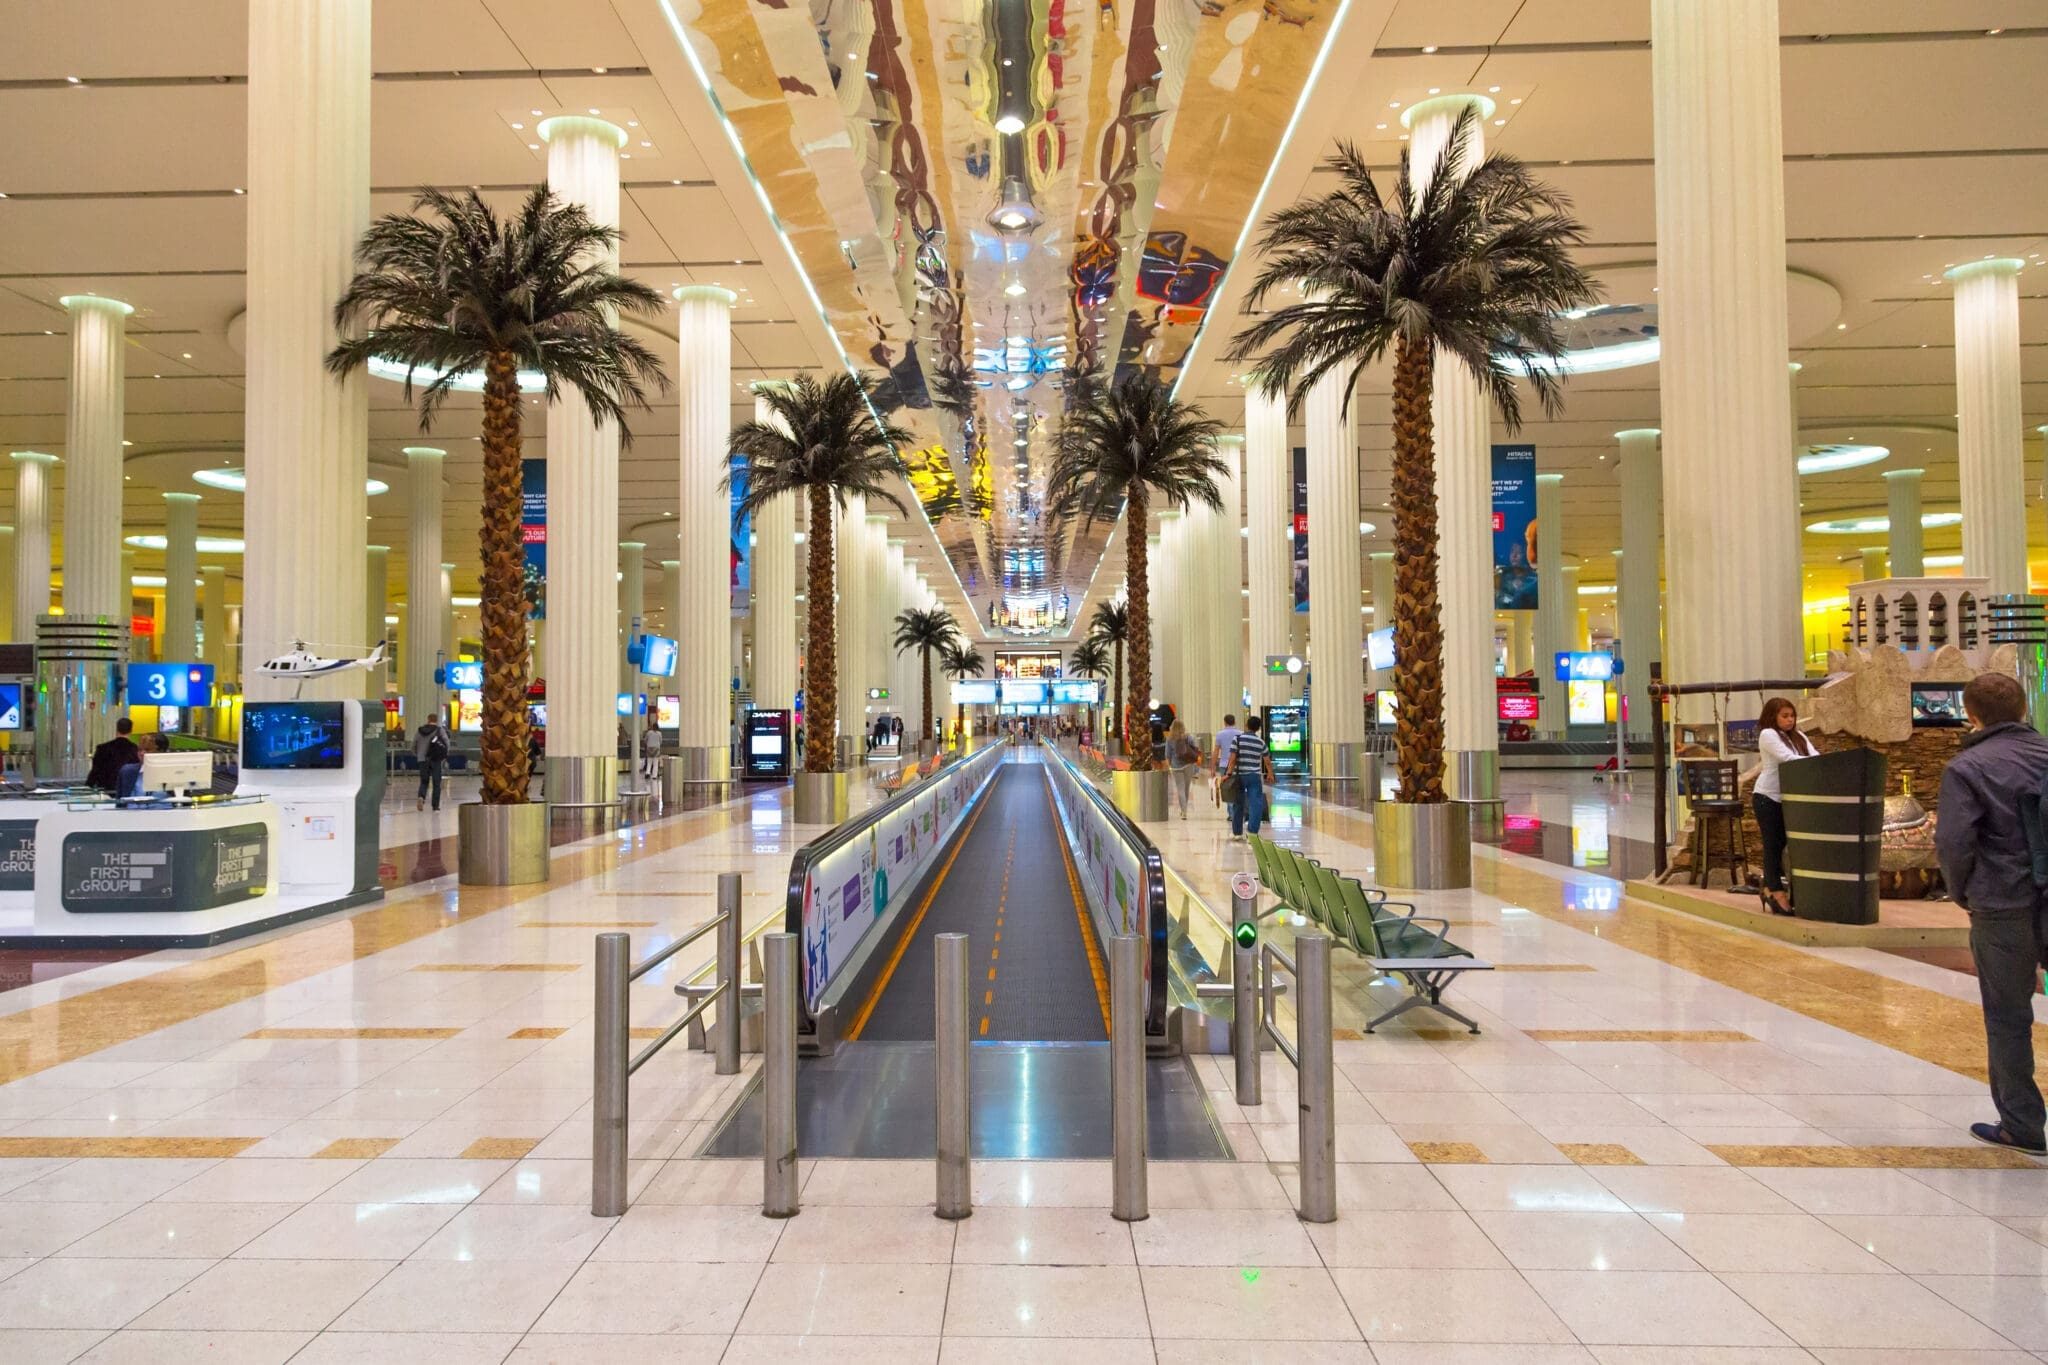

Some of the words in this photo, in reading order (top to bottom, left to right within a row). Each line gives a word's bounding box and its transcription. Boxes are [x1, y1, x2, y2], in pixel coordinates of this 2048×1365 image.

[1575, 656, 1604, 676] 4A
[451, 666, 482, 685] 3A
[148, 673, 167, 699] 3
[19, 839, 36, 850] TH
[9, 850, 36, 861] FIRS
[102, 853, 130, 865] THE
[228, 846, 243, 860] THE
[0, 861, 35, 872] GROU
[221, 858, 242, 873] FIRST
[90, 867, 130, 879] FIRST
[216, 871, 242, 886] GROUP
[80, 879, 130, 892] GROUP
